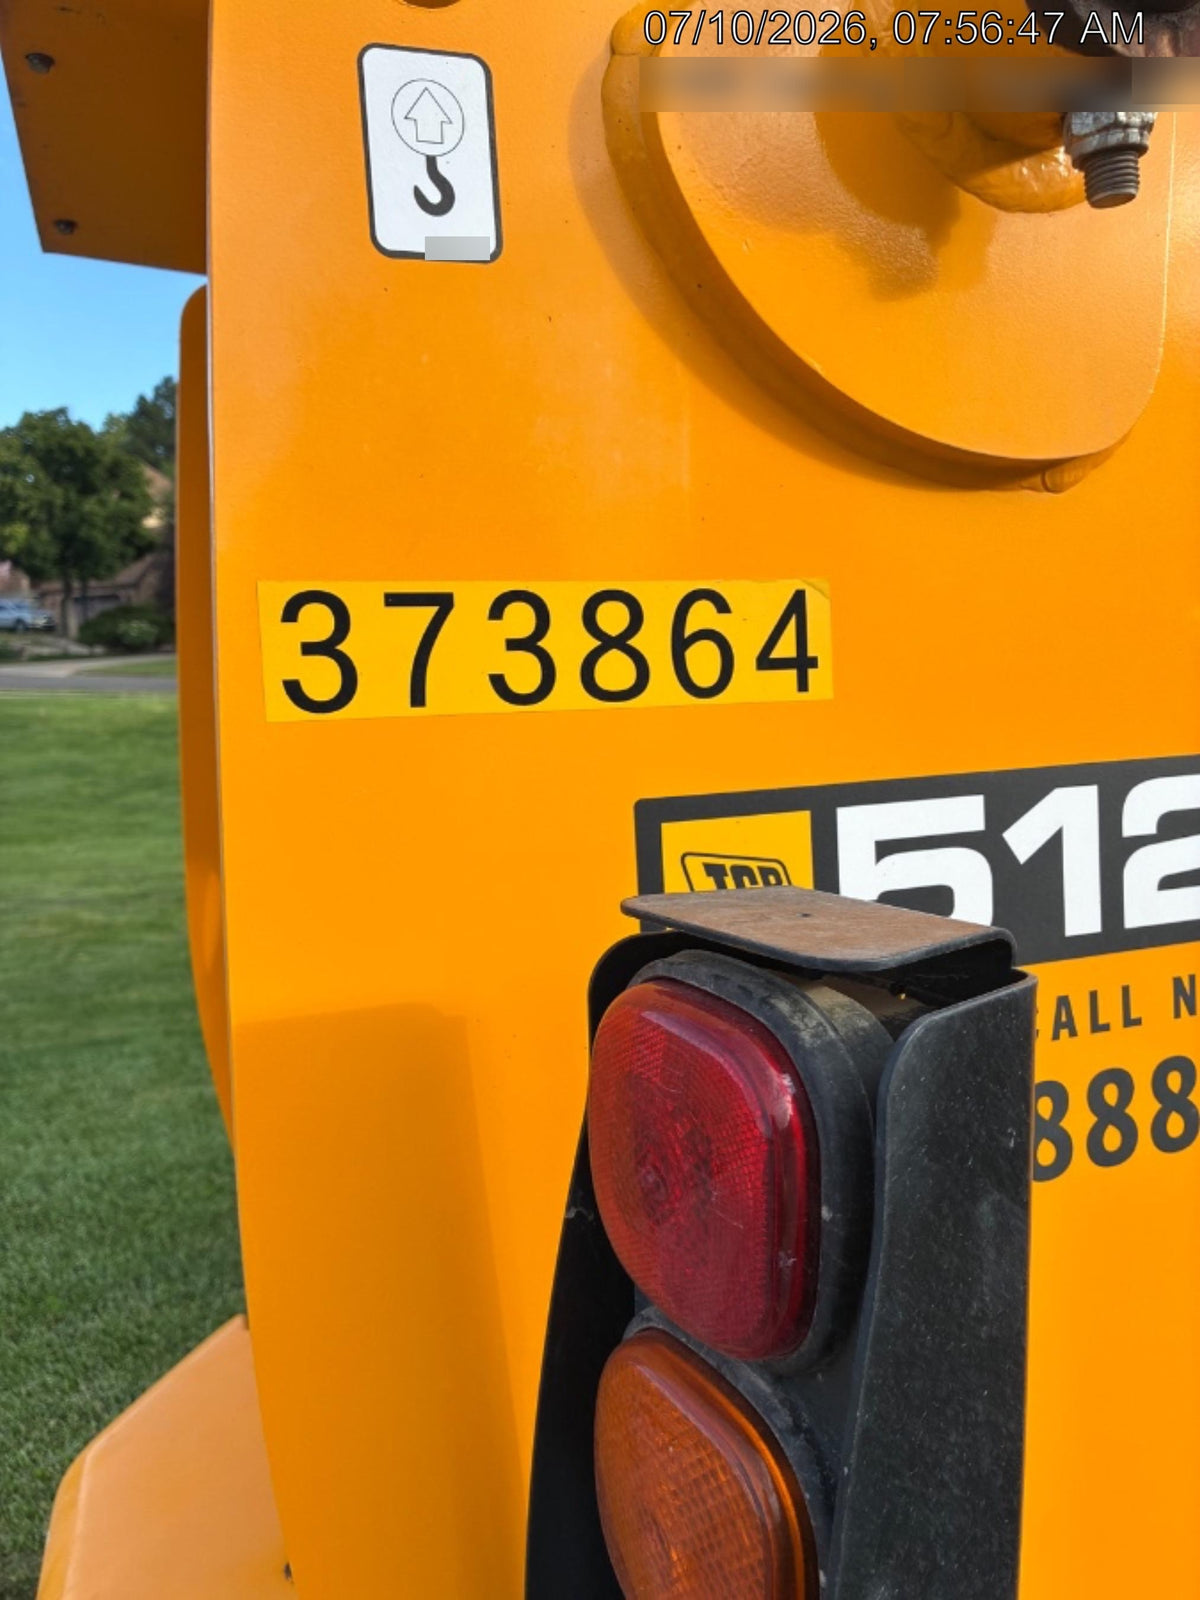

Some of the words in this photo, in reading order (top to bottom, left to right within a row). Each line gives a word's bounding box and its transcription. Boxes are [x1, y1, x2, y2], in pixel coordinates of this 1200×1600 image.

[280, 588, 819, 714] 373864
[1036, 984, 1143, 1041] ALL
[1032, 1054, 1200, 1183] 888
